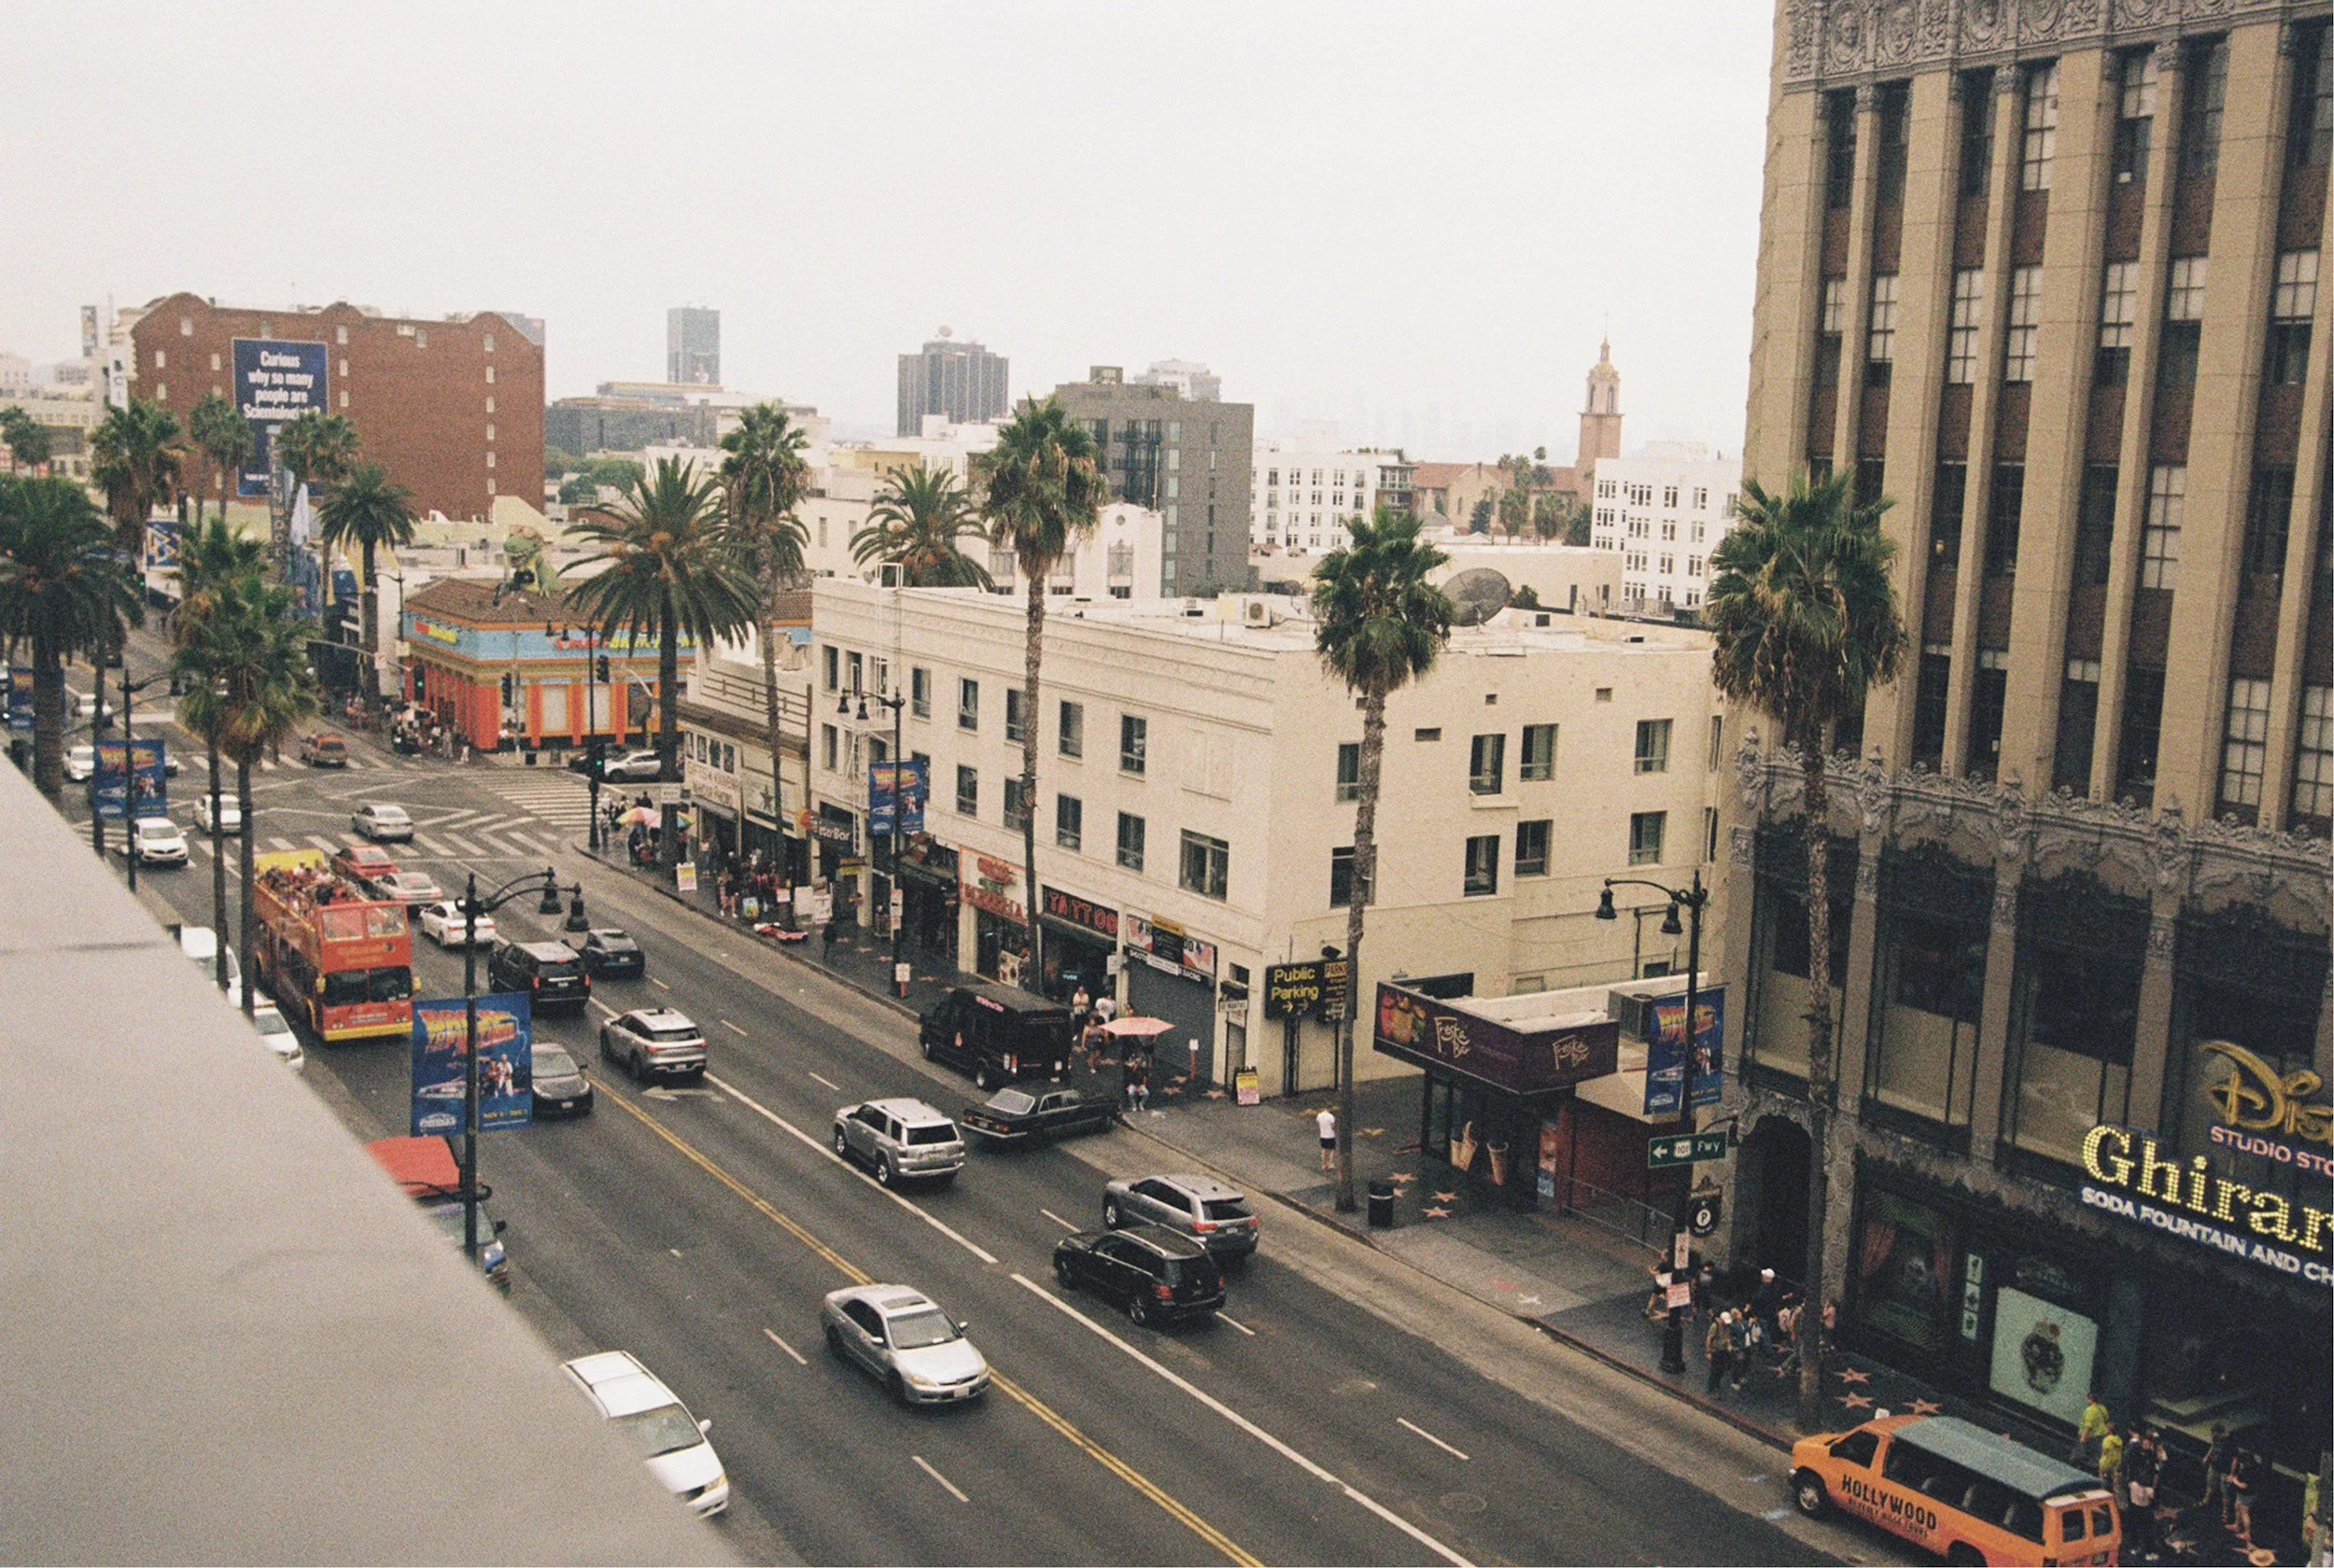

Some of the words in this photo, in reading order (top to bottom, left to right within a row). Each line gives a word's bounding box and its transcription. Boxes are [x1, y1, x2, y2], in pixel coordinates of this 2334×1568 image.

[260, 351, 301, 368] Curious
[248, 369, 270, 386] why
[272, 372, 284, 385] so
[286, 373, 314, 388] many
[256, 387, 289, 407] people
[290, 391, 308, 403] are
[1048, 891, 1118, 934] TATTOO
[1273, 967, 1315, 983] Public
[1271, 986, 1320, 1001] Parking
[1677, 1143, 1690, 1155] 101
[2211, 1126, 2292, 1164] STUDIO
[2081, 1186, 2138, 1221] SODA
[2140, 1204, 2245, 1257] FOUNTAIN
[2249, 1243, 2300, 1275] AND
[1842, 1474, 1936, 1531] HOLLYWOOD
